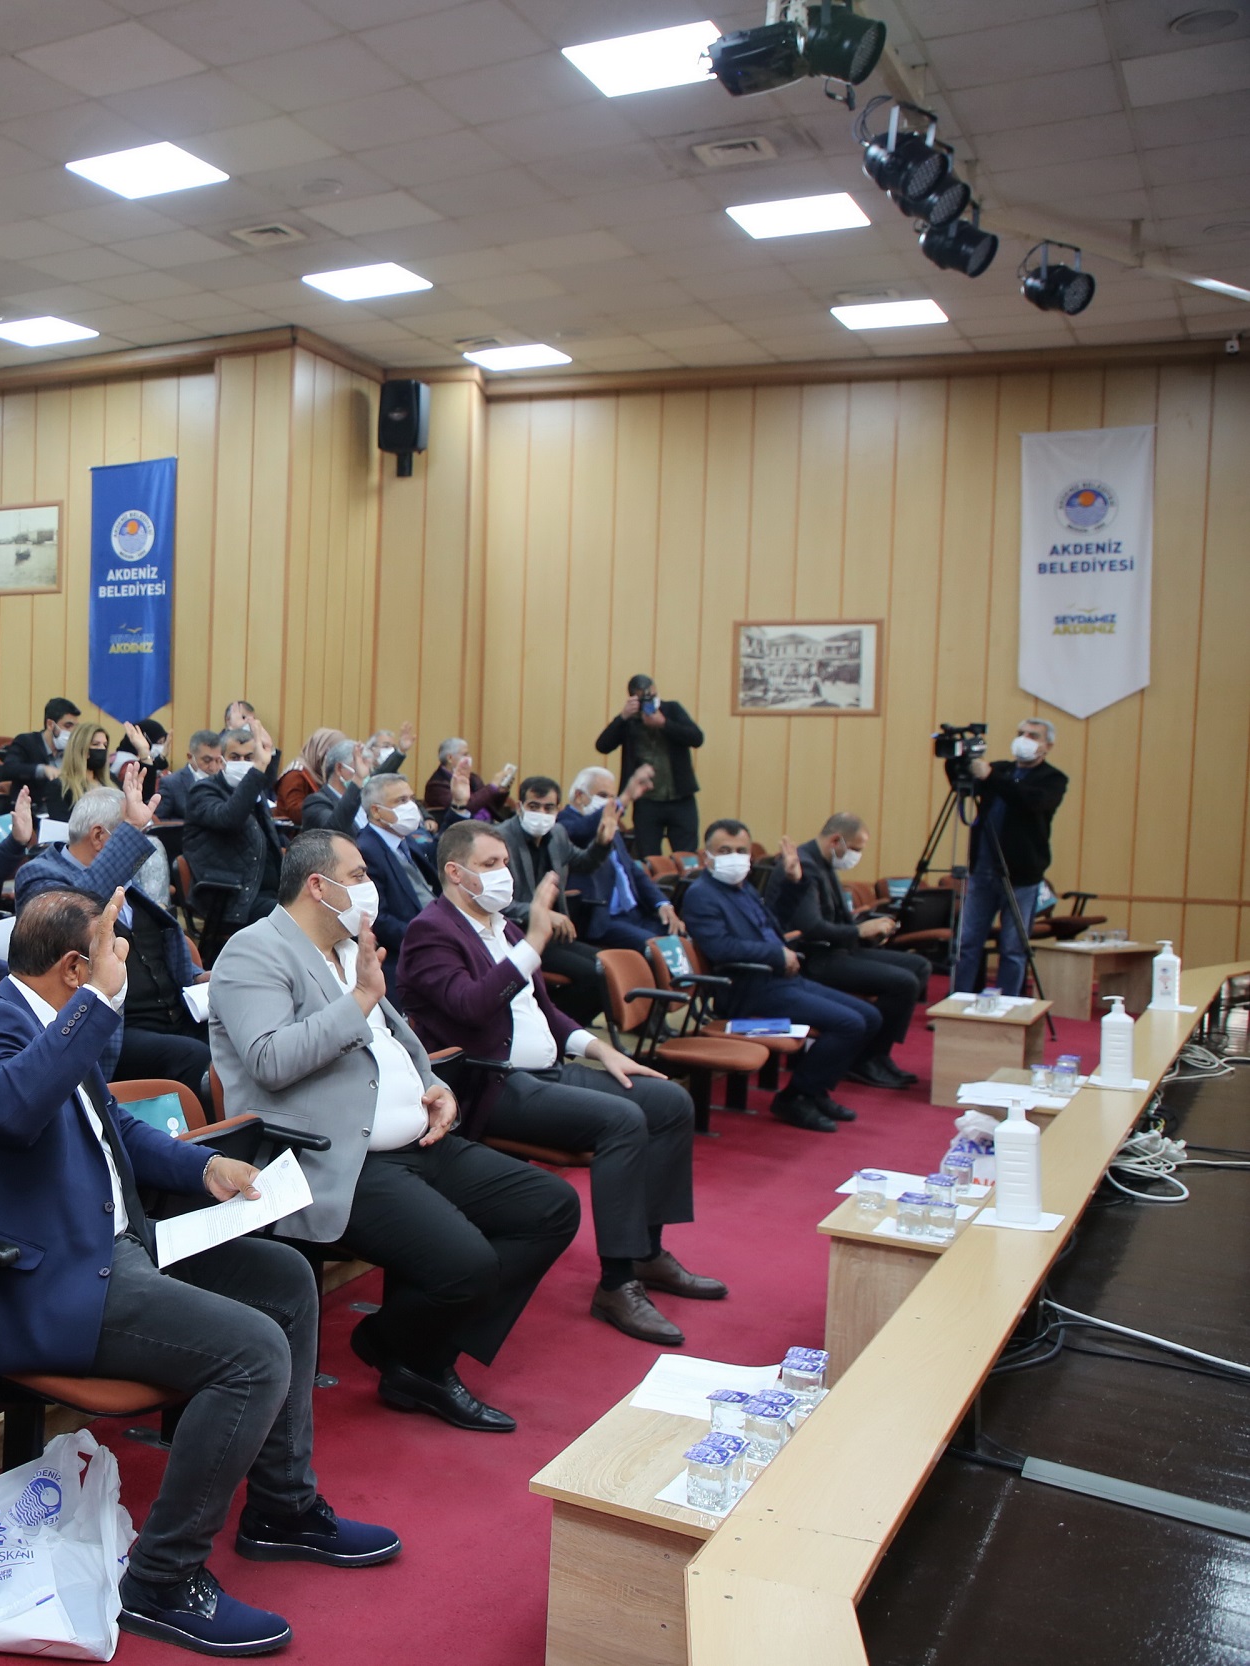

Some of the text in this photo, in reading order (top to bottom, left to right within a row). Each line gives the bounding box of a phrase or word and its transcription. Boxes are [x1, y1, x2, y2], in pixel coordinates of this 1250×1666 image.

[1049, 539, 1122, 555] AKDENİZ
[107, 564, 158, 581] AKDENİZ
[1038, 556, 1135, 575] BELEDİYESİ
[98, 580, 166, 598] BELEDİYESİ
